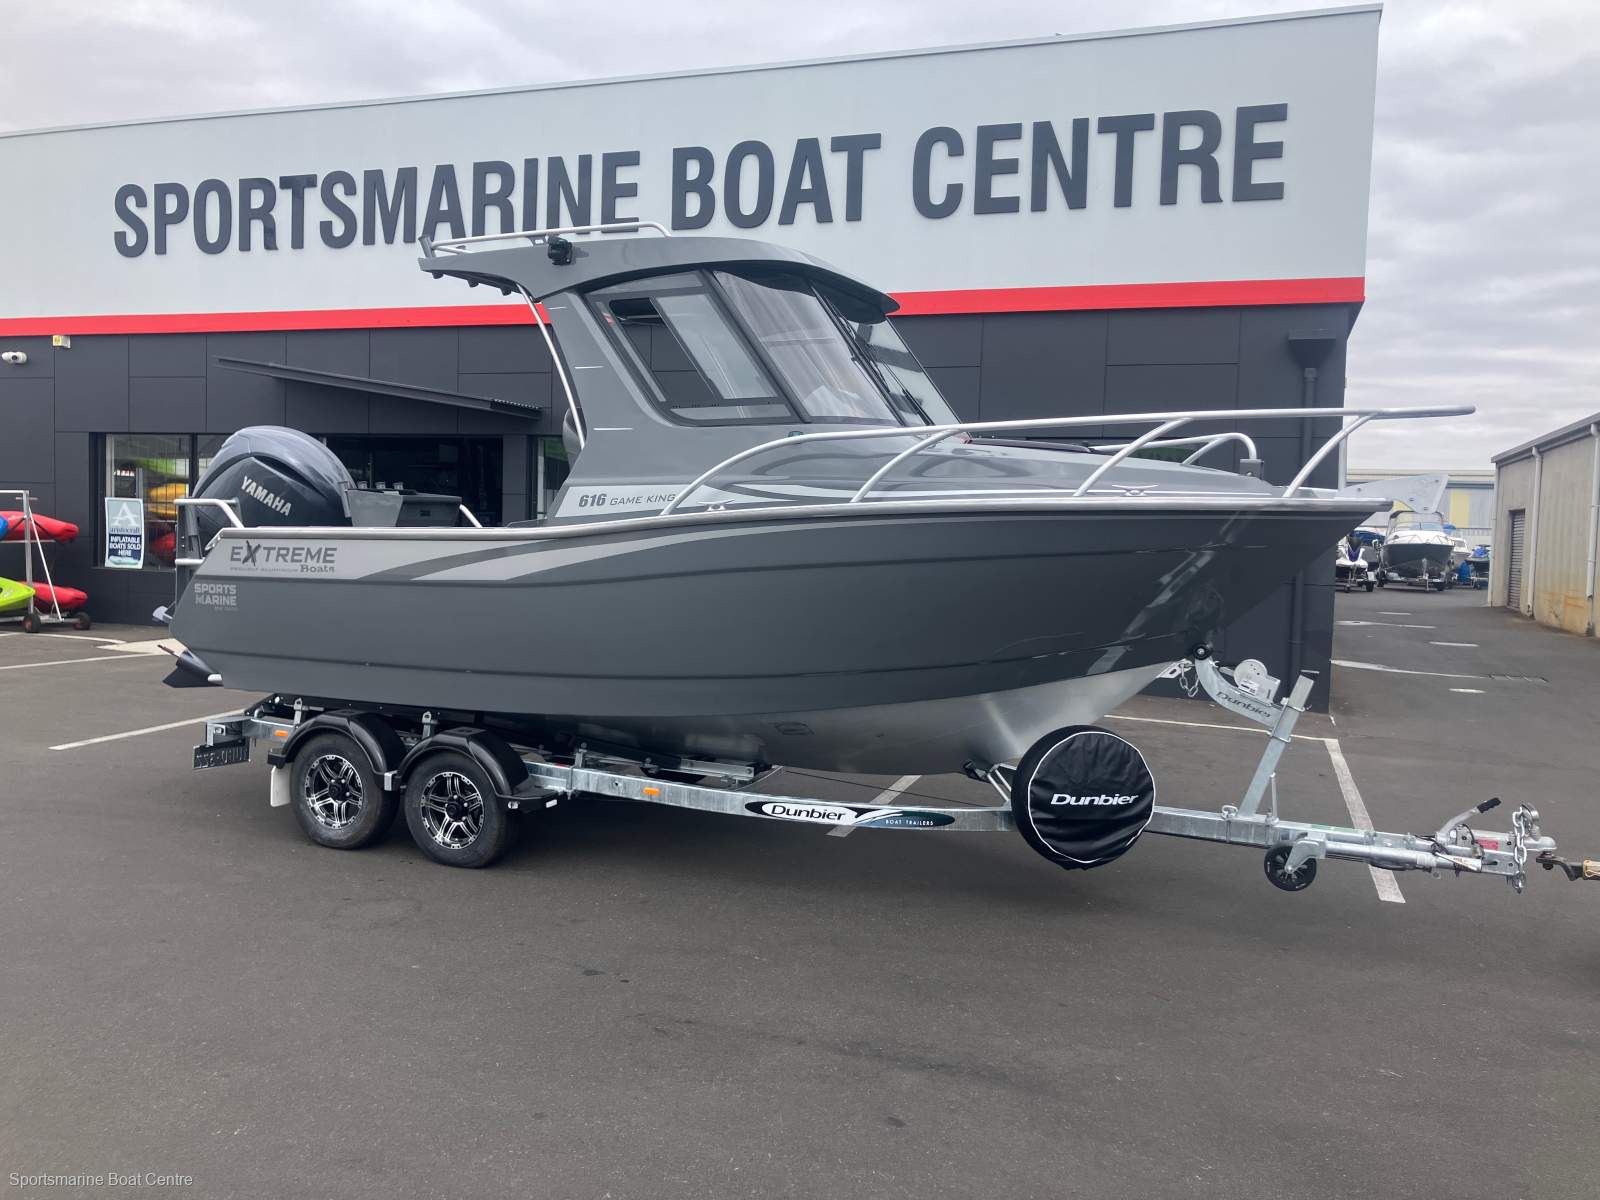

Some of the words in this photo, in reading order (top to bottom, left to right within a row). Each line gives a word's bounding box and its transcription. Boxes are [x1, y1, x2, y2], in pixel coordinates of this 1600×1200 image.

[114, 150, 641, 258] SPORTSMARINE
[671, 132, 882, 231] BOAT
[912, 102, 1289, 219] CENTRE
[241, 475, 292, 516] YAMAHA
[578, 493, 607, 508] 616
[609, 496, 644, 506] GAME
[646, 493, 676, 503] KING
[110, 535, 140, 543] INFLATABLE
[109, 542, 127, 550] BOATS
[127, 543, 141, 551] SOLD
[118, 549, 132, 557] HERE
[230, 540, 337, 566] EXTREME
[300, 564, 335, 573] Boats
[194, 583, 237, 595] SPORTS
[195, 594, 237, 606] MARINE
[1216, 691, 1272, 718] Dunbier
[1050, 793, 1139, 806] Dunbier
[771, 804, 846, 821] Dunbier
[905, 819, 934, 827] TRAILERS
